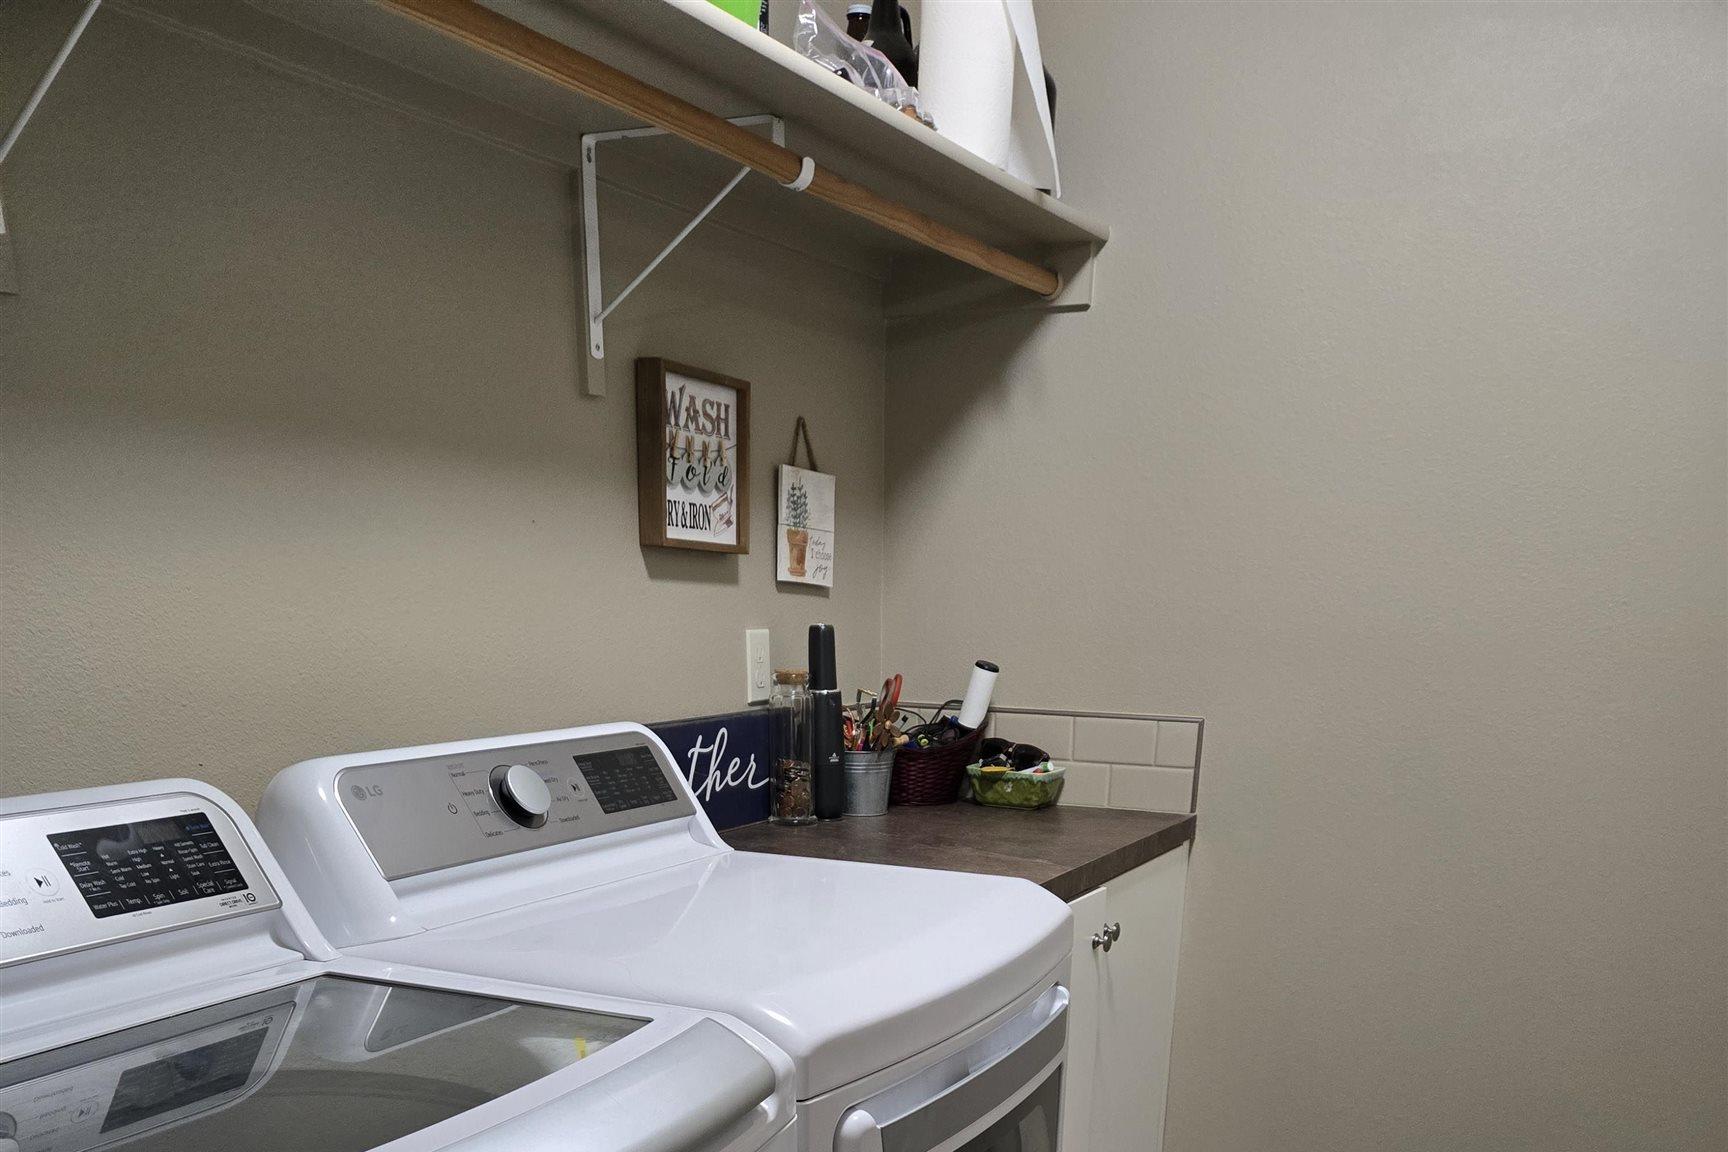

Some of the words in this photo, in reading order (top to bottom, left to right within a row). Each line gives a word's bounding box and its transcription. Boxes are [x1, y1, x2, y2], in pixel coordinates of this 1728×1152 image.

[665, 383, 731, 441] WASH
[364, 785, 384, 797] LG
[0, 897, 29, 907] edding
[1, 923, 45, 938] Downloaded
